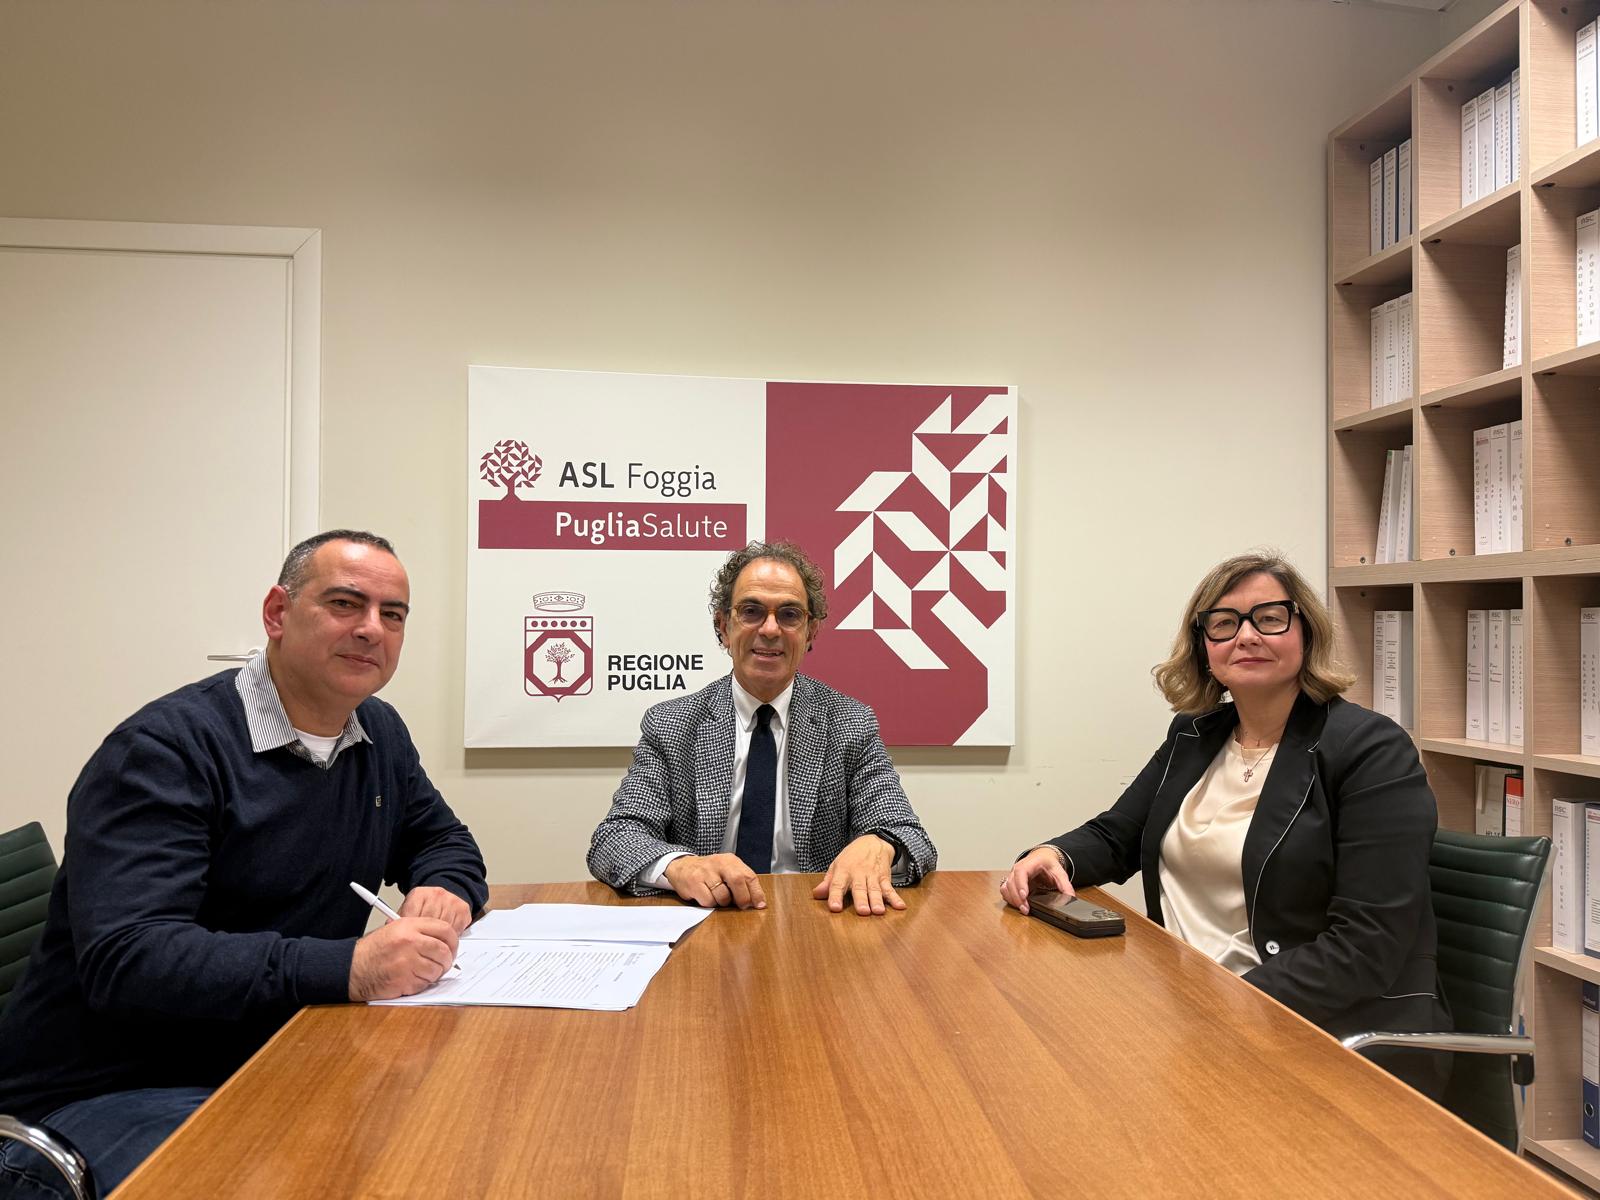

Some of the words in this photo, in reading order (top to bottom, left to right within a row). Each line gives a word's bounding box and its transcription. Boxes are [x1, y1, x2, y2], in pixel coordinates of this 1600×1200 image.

[558, 461, 615, 488] ASL
[628, 463, 717, 498] Foggia
[556, 511, 728, 545] PugliaSalute
[608, 654, 704, 671] REGIONE
[608, 674, 687, 691] PUGLIA
